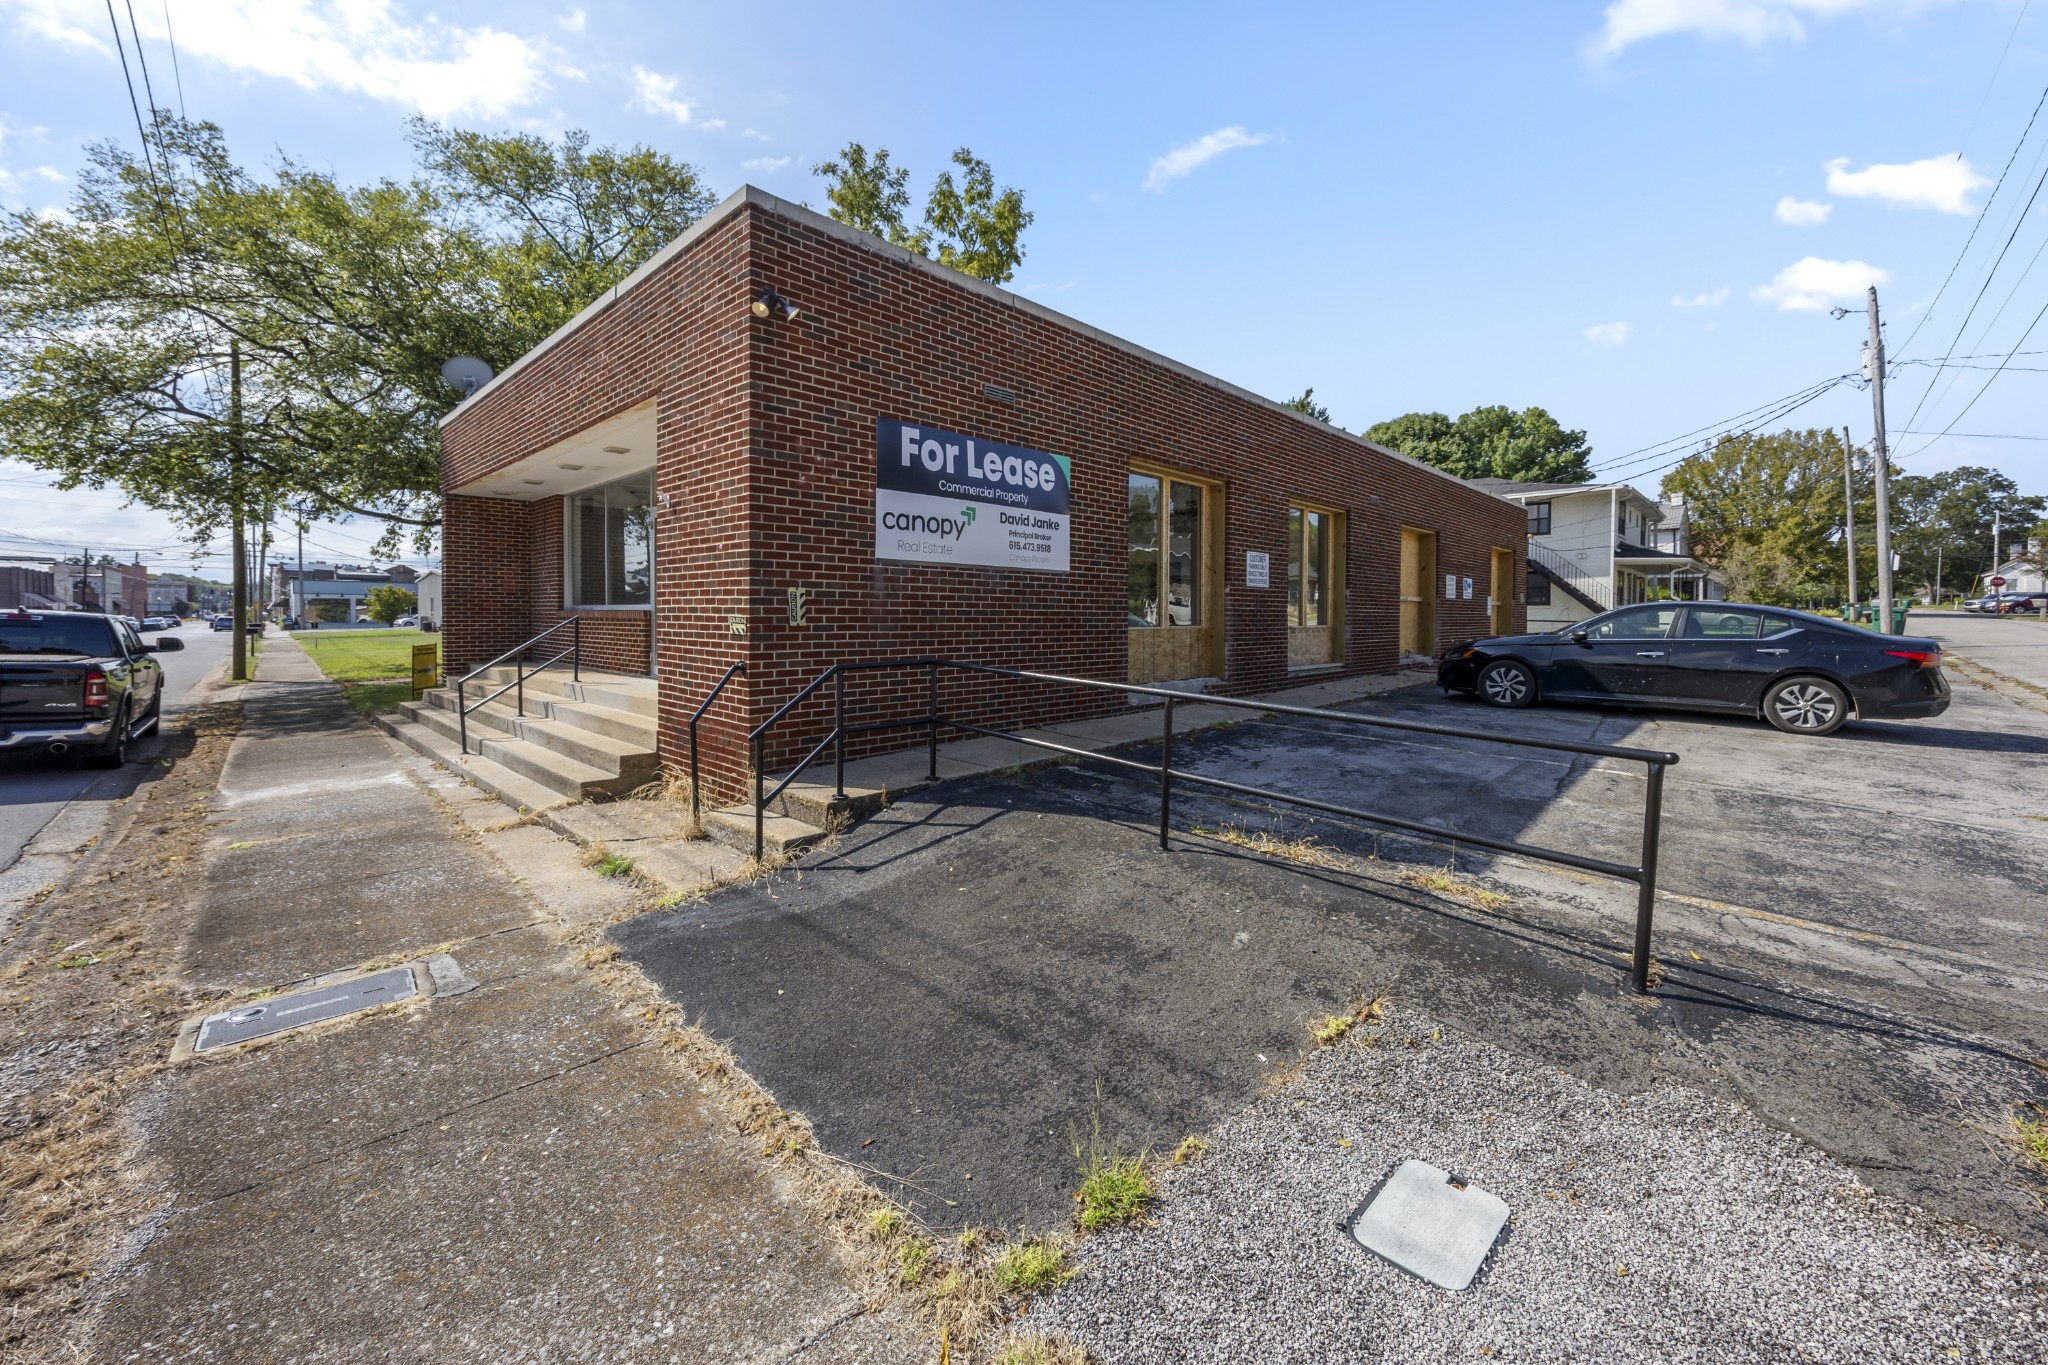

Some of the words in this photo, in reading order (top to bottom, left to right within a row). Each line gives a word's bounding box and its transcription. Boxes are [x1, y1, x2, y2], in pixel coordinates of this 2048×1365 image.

[901, 425, 960, 474] For
[966, 440, 1056, 492] Lease
[938, 480, 995, 499] Commercial
[995, 489, 1029, 506] Property
[882, 511, 966, 541] canopy
[1000, 512, 1030, 527] David
[1031, 516, 1060, 531] Janke
[1008, 530, 1034, 541] Principal
[1034, 532, 1052, 541] Broker
[897, 539, 920, 553] Real
[922, 541, 953, 555] Estate
[1008, 540, 1052, 553] 615.473.9518
